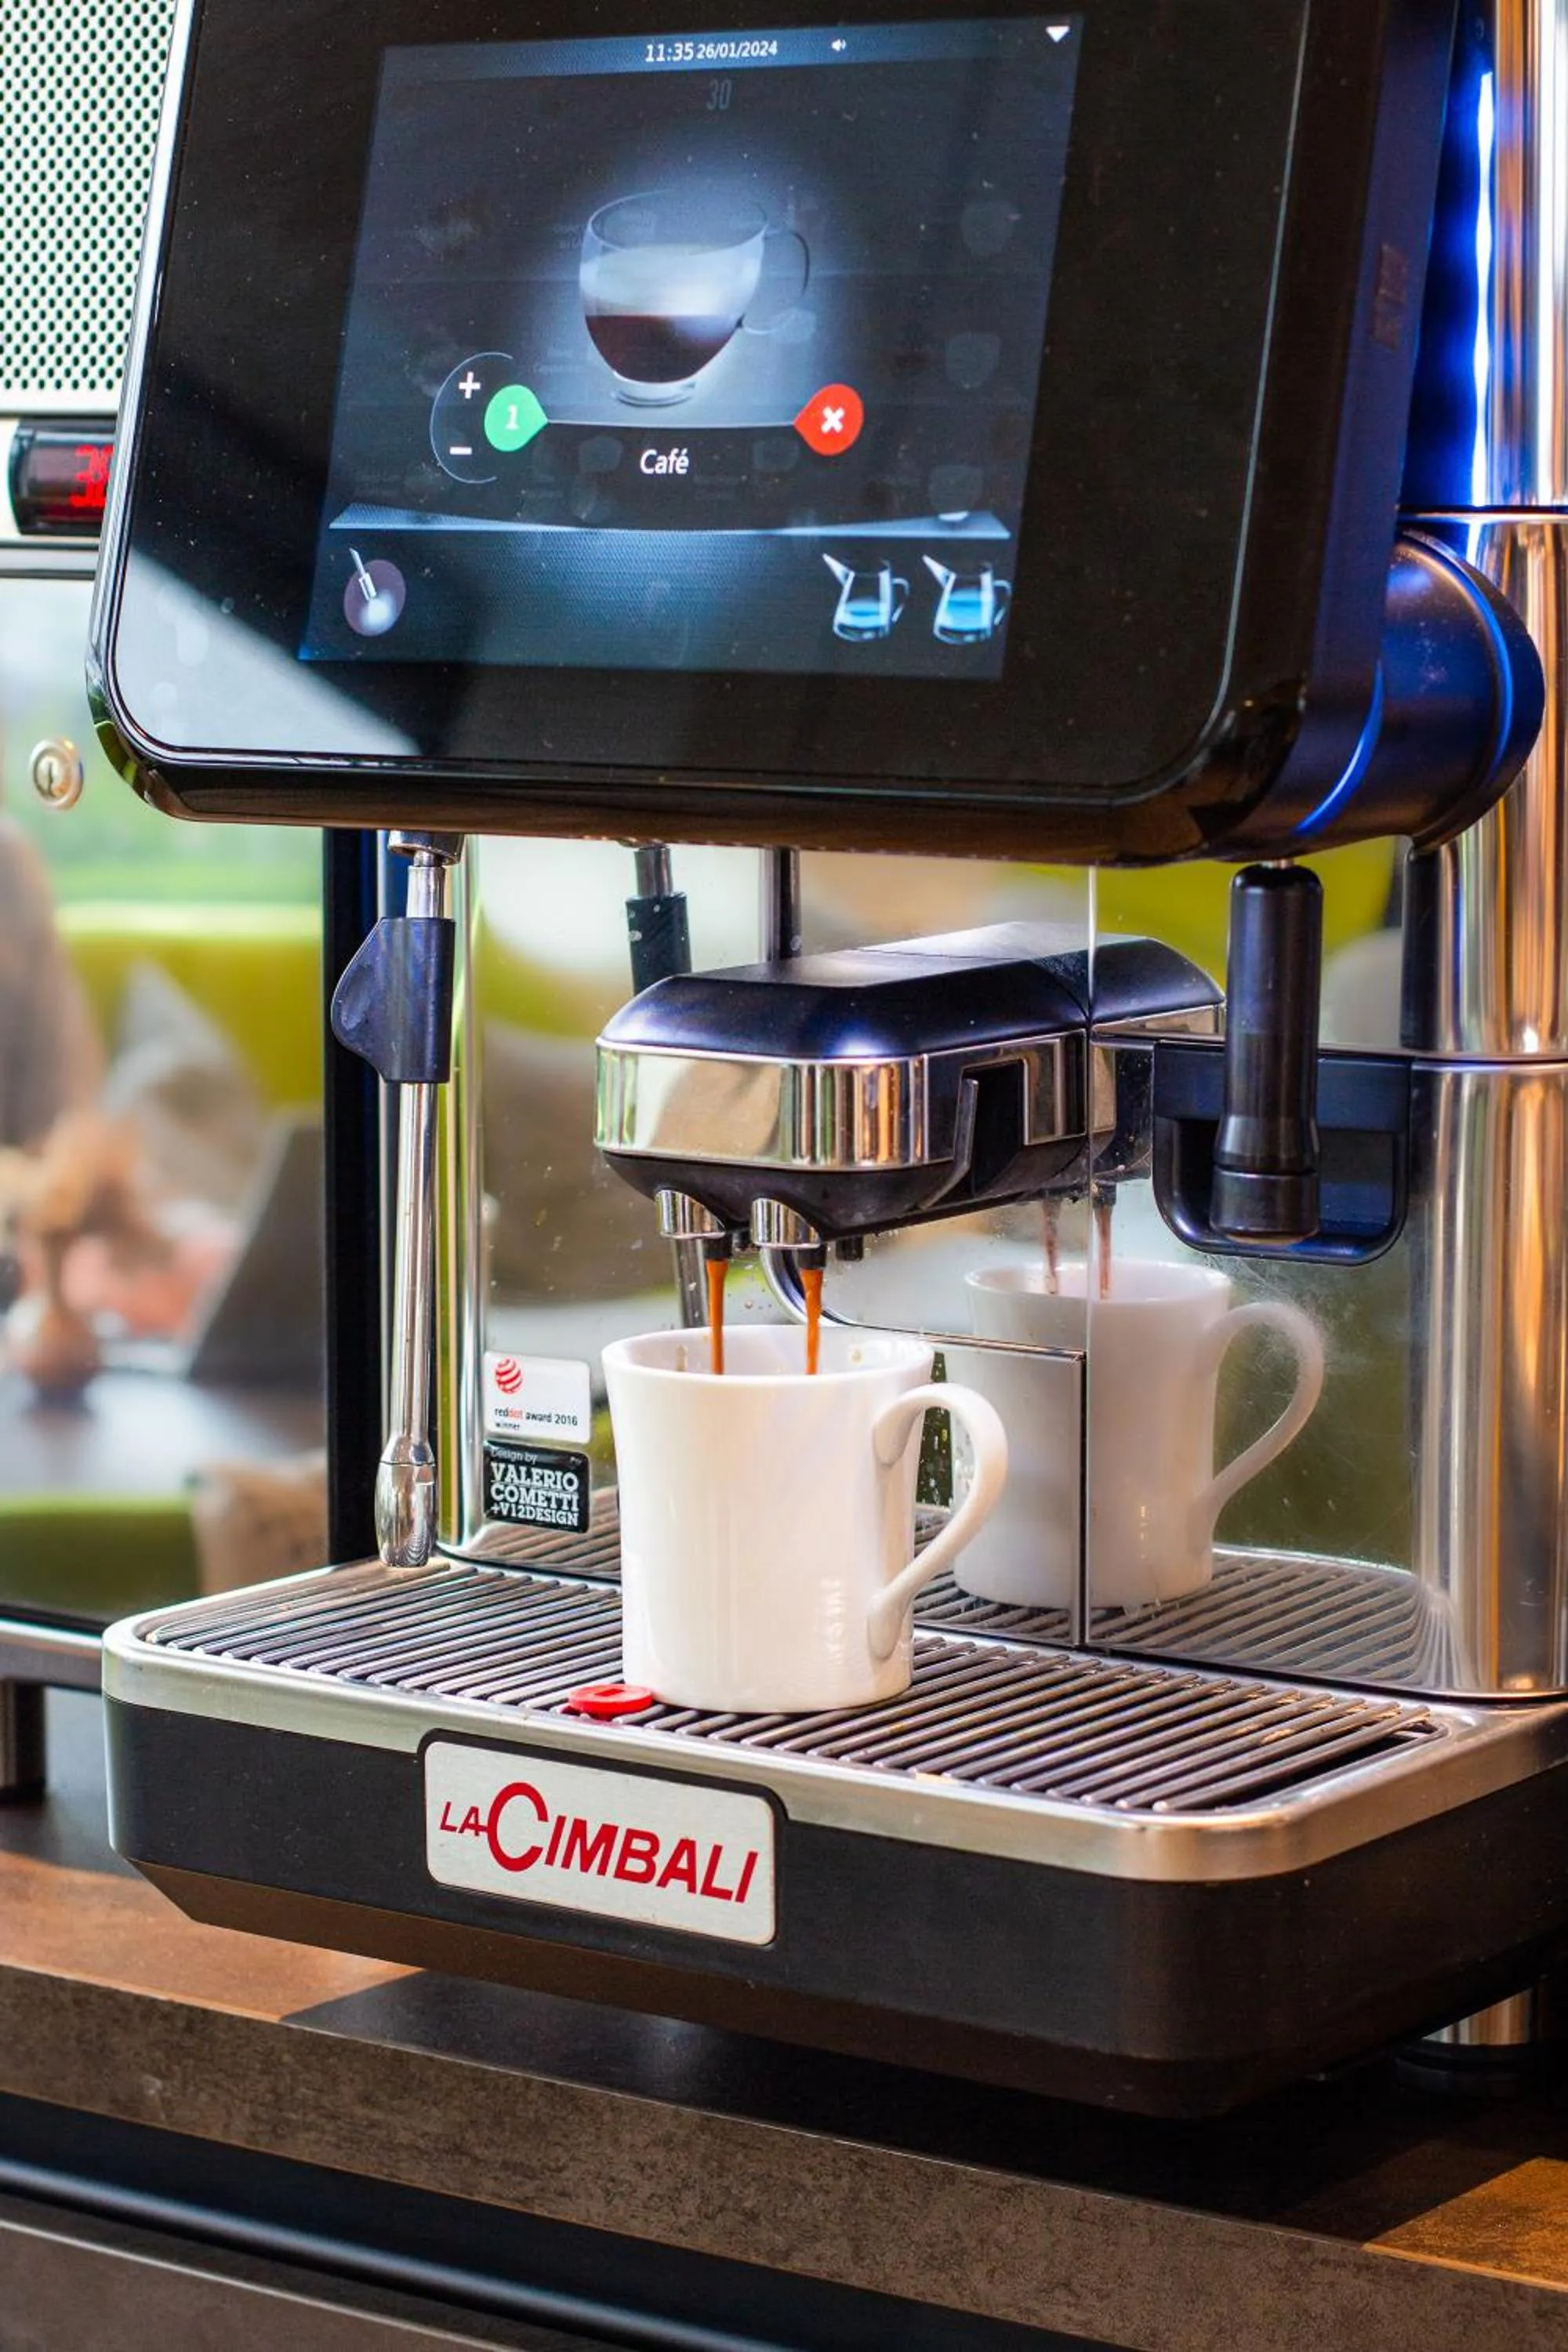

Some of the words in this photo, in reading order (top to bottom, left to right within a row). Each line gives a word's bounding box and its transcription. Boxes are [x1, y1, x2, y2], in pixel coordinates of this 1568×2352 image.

[644, 42, 694, 63] 11:35
[695, 39, 779, 60] 26/01/2024
[706, 78, 732, 110] 30
[505, 403, 520, 431] 1
[639, 448, 690, 475] Café
[525, 1411, 553, 1424] award
[554, 1414, 579, 1427] 2016
[524, 1451, 537, 1465] by
[490, 1461, 579, 1493] VALERIO
[490, 1482, 579, 1512] COMETTI
